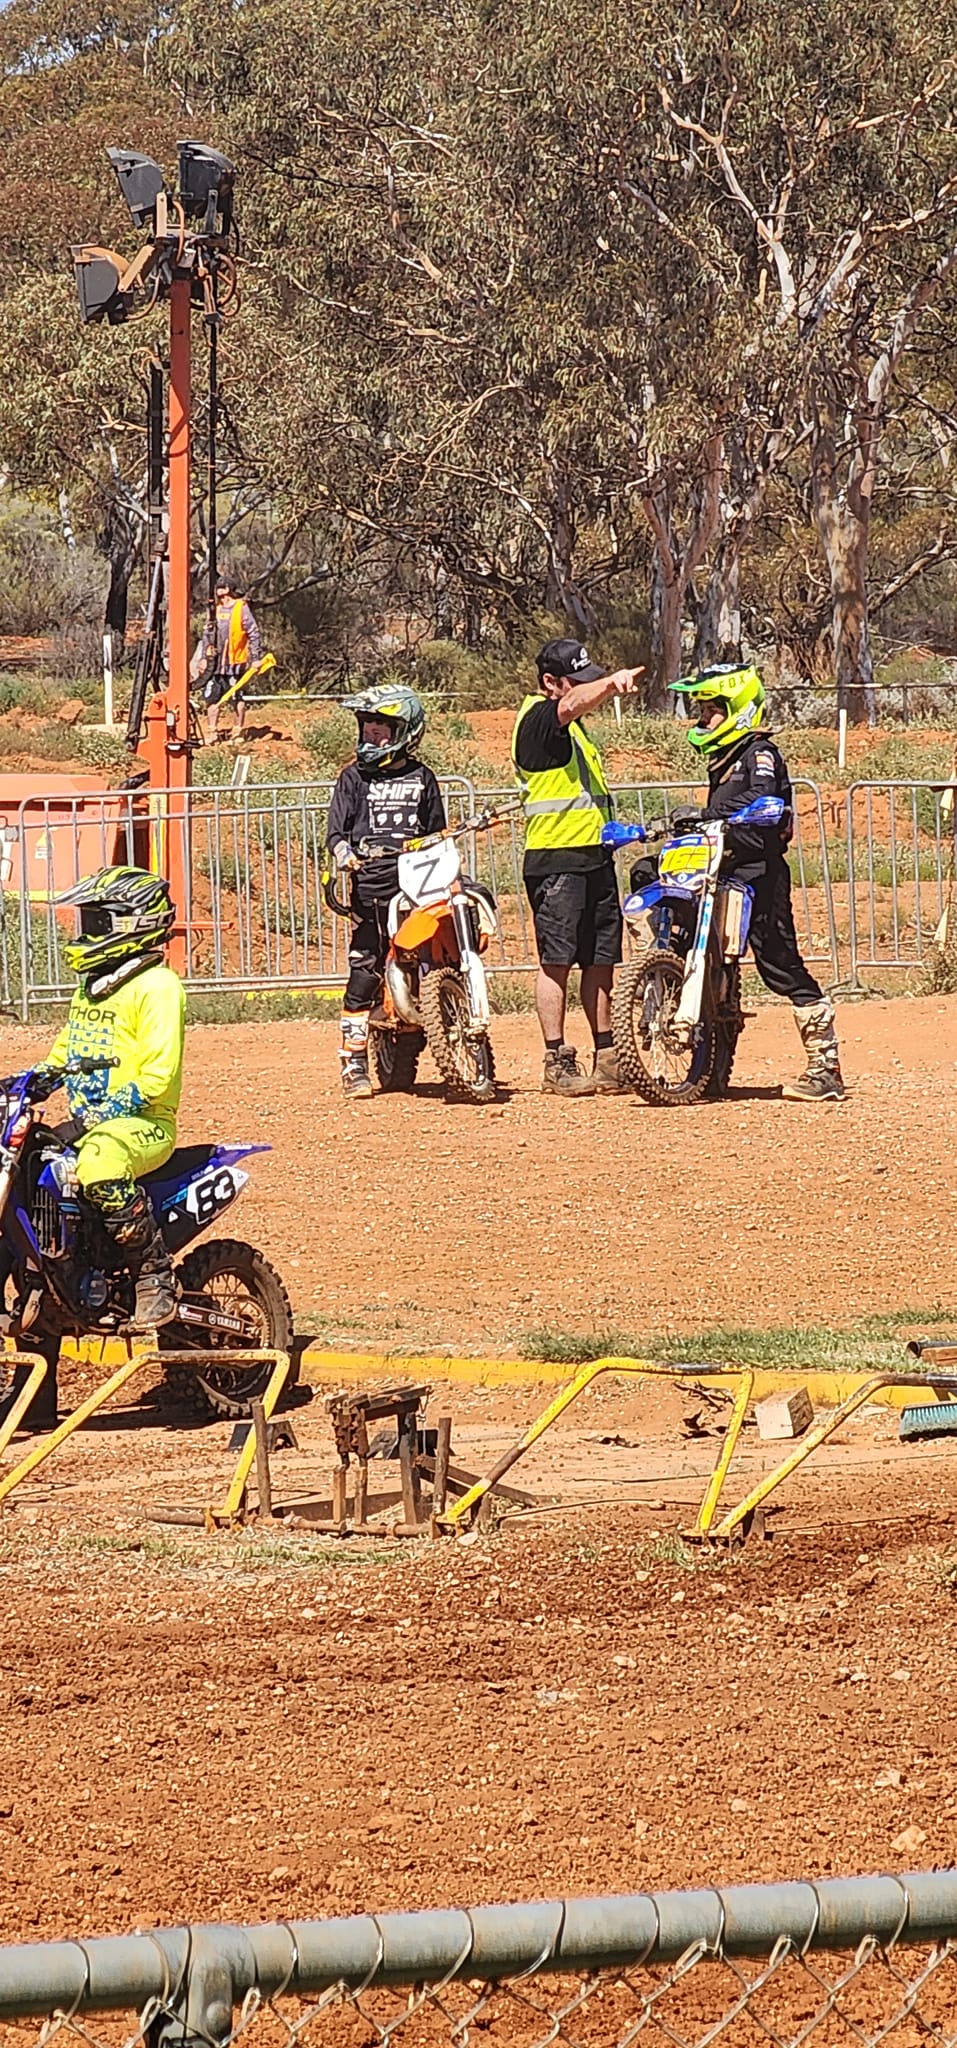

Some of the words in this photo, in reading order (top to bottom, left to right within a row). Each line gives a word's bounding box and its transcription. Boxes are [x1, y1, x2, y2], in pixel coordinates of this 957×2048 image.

[719, 675, 746, 692] FOX
[367, 783, 425, 800] SHIFT
[412, 857, 447, 899] Z
[71, 1006, 117, 1025] THOR
[130, 1125, 166, 1145] THO
[195, 1169, 236, 1222] 83
[216, 1315, 241, 1331] YAMAHA
